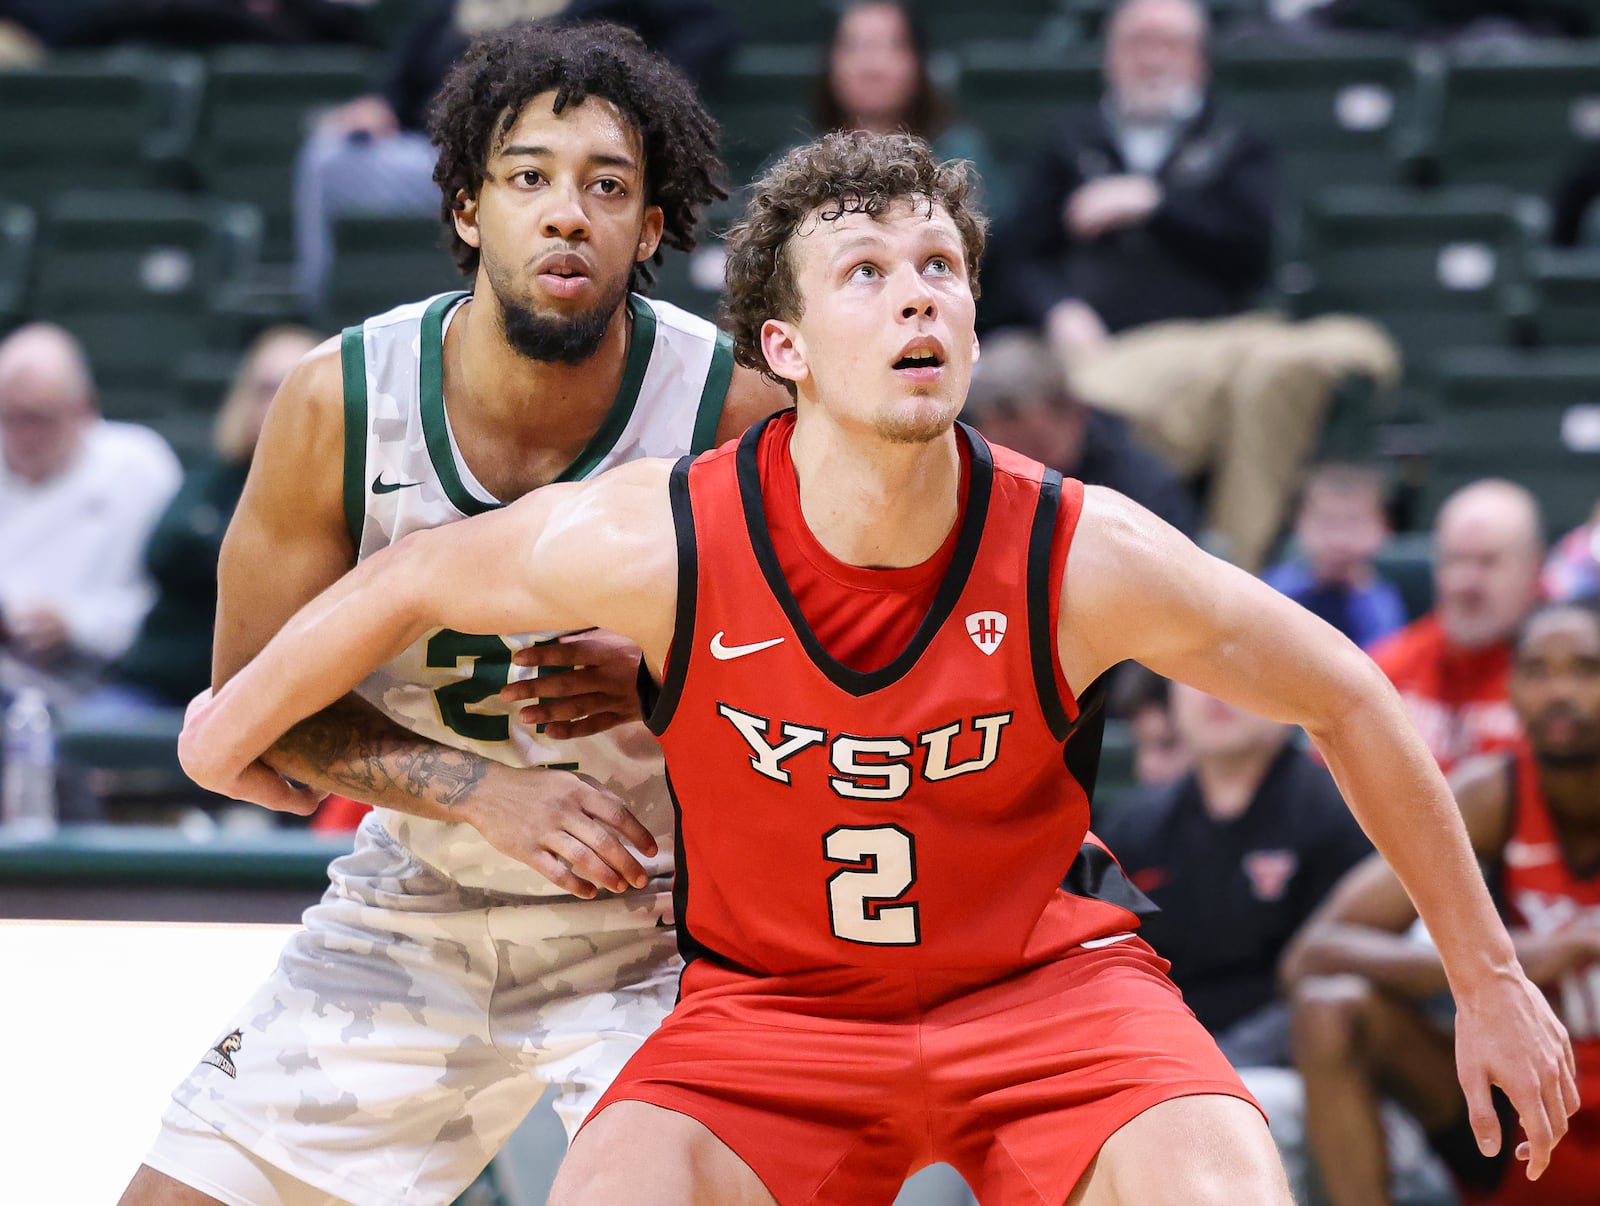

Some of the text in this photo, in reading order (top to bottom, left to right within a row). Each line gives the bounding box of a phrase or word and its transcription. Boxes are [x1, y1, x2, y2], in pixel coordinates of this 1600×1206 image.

[425, 628, 580, 741] 2
[717, 701, 1014, 801] YSU
[822, 823, 922, 946] 2
